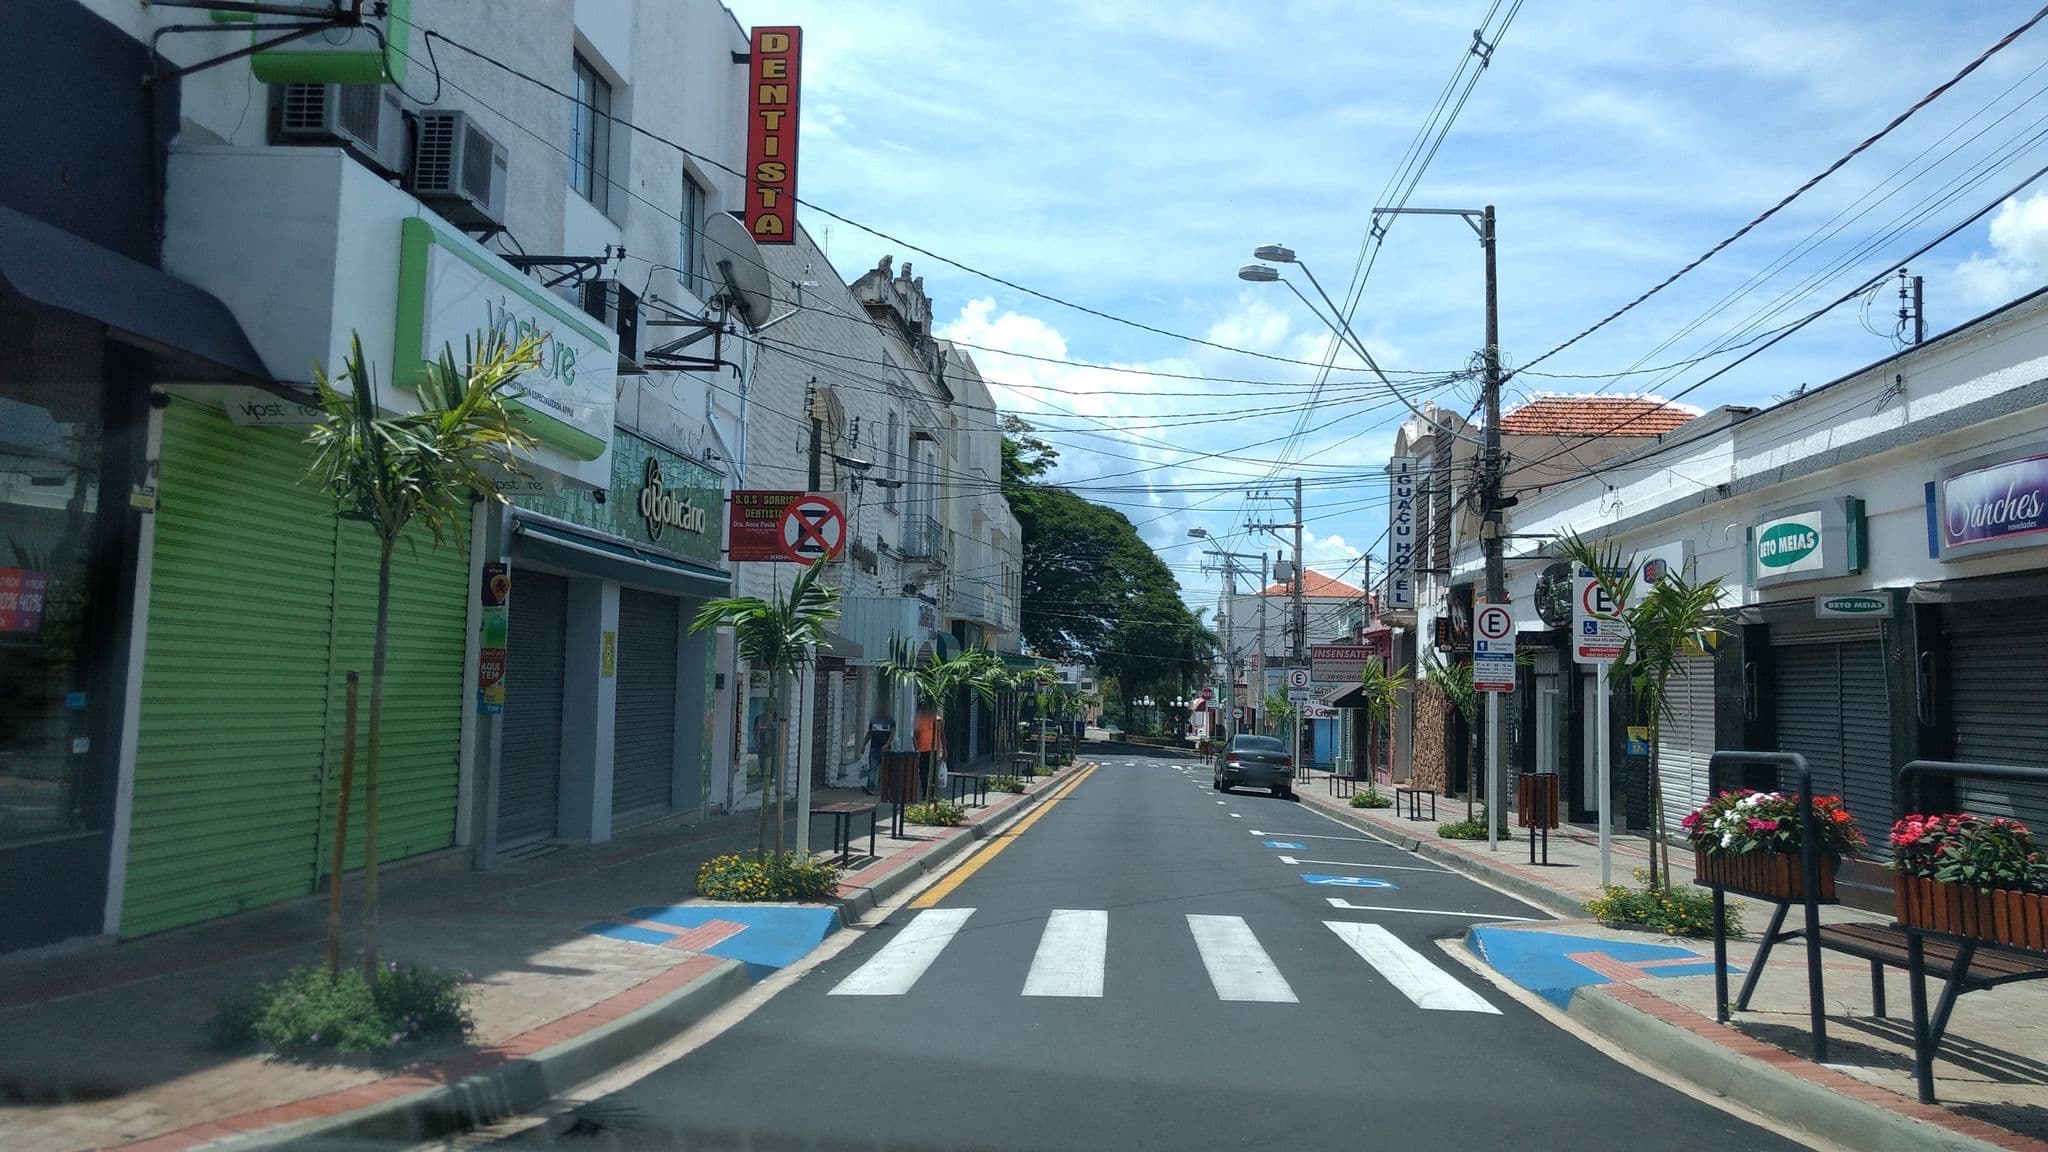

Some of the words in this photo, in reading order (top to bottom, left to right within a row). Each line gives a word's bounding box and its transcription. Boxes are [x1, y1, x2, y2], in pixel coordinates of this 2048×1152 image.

[754, 33, 790, 236] DENTISTA
[1396, 462, 1412, 537] IGUAÇU
[1950, 481, 2044, 537] Sanches
[2008, 520, 2038, 531] novidades
[1760, 539, 1777, 558] BETO
[1778, 531, 1815, 554] MEIAS
[1597, 587, 1613, 612] E
[1828, 601, 1851, 609] BETO
[1854, 601, 1883, 609] MEIAS
[1488, 613, 1501, 633] E
[1313, 649, 1373, 659] INSENSATEZ
[1295, 673, 1303, 684] E
